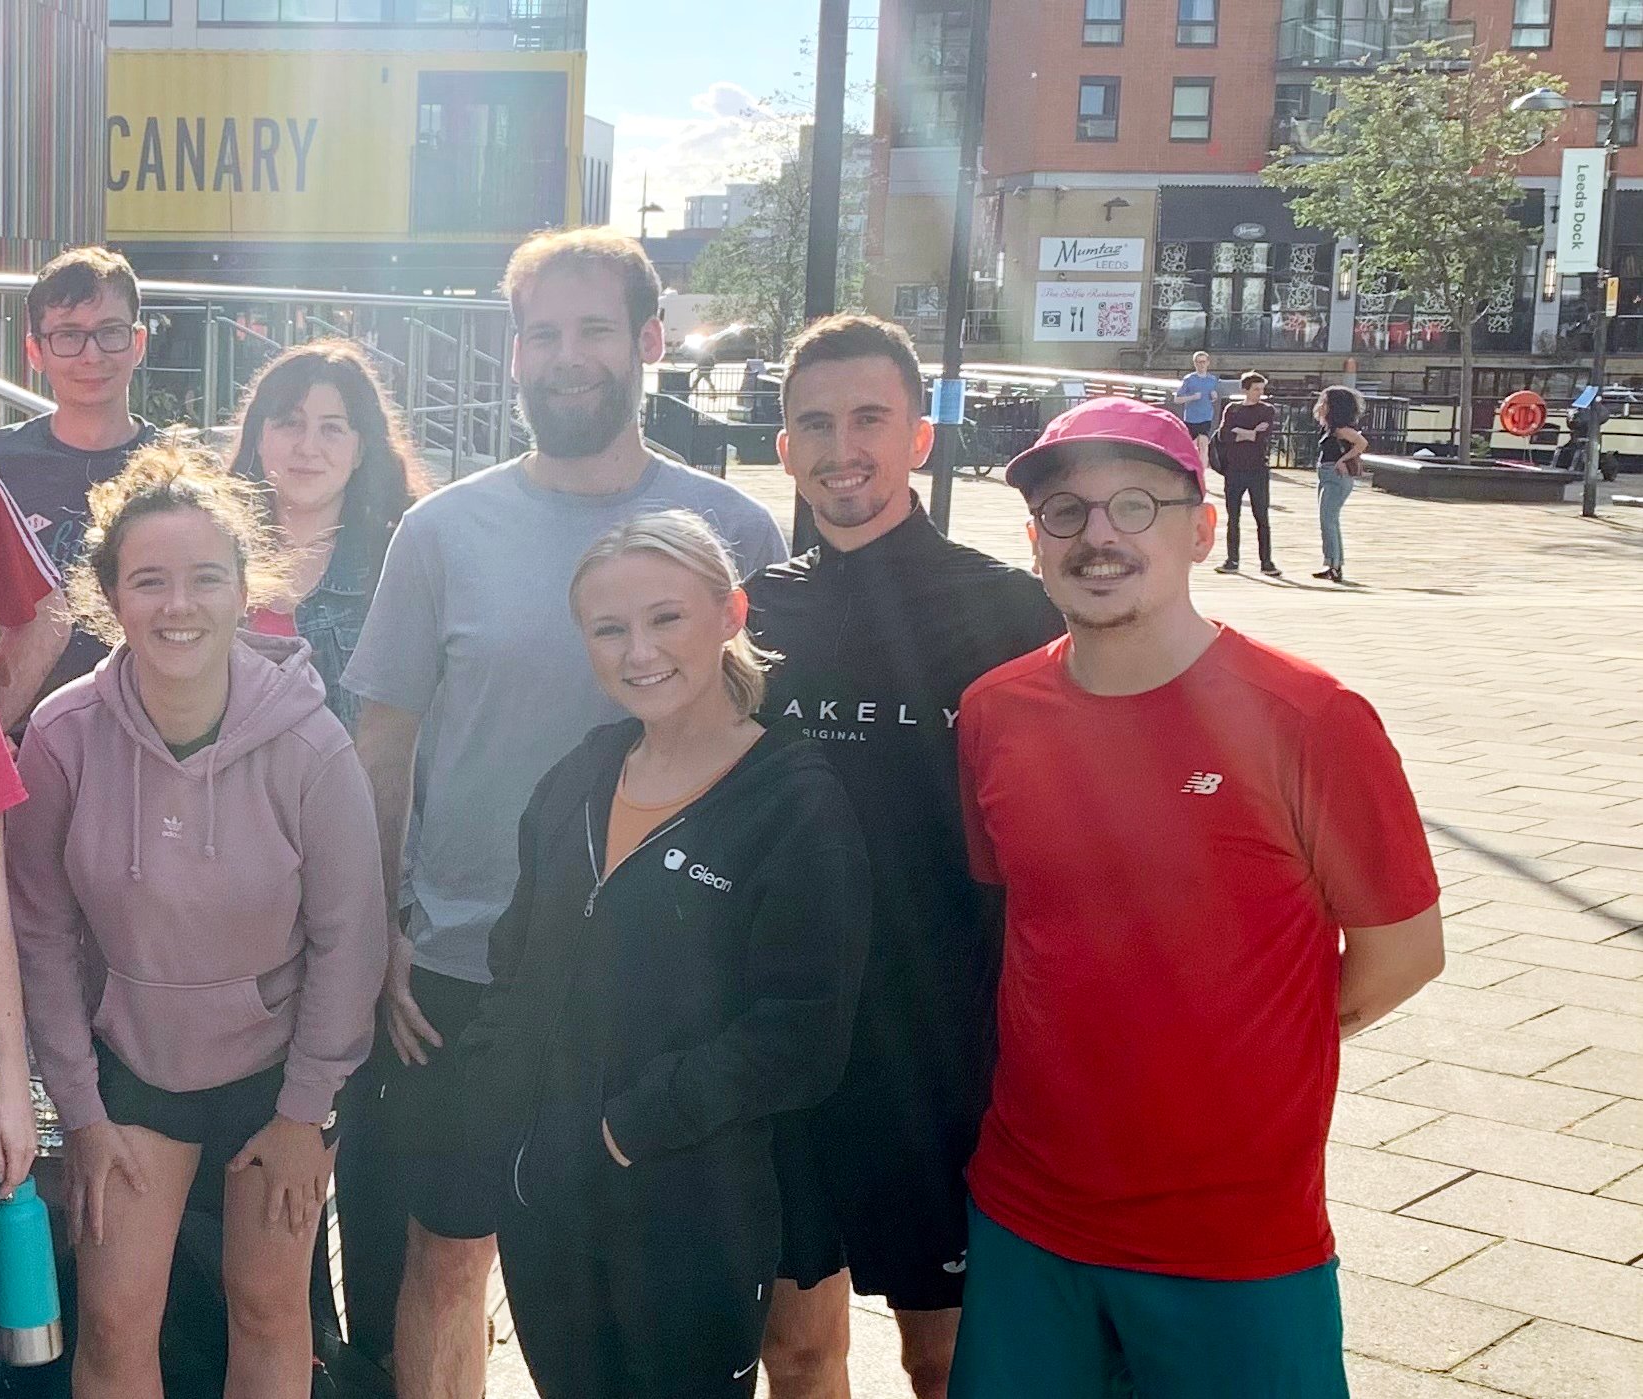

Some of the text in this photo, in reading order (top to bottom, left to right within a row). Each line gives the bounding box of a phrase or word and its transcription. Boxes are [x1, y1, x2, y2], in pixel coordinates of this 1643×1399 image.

[105, 115, 318, 192] CANARY
[1572, 164, 1589, 250] Leeds Dock
[1053, 240, 1123, 268] Mumtaz
[1096, 260, 1129, 269] LEEDS
[783, 698, 960, 729] AKELY
[802, 728, 867, 742] RIGINAL
[688, 864, 733, 893] Glean
